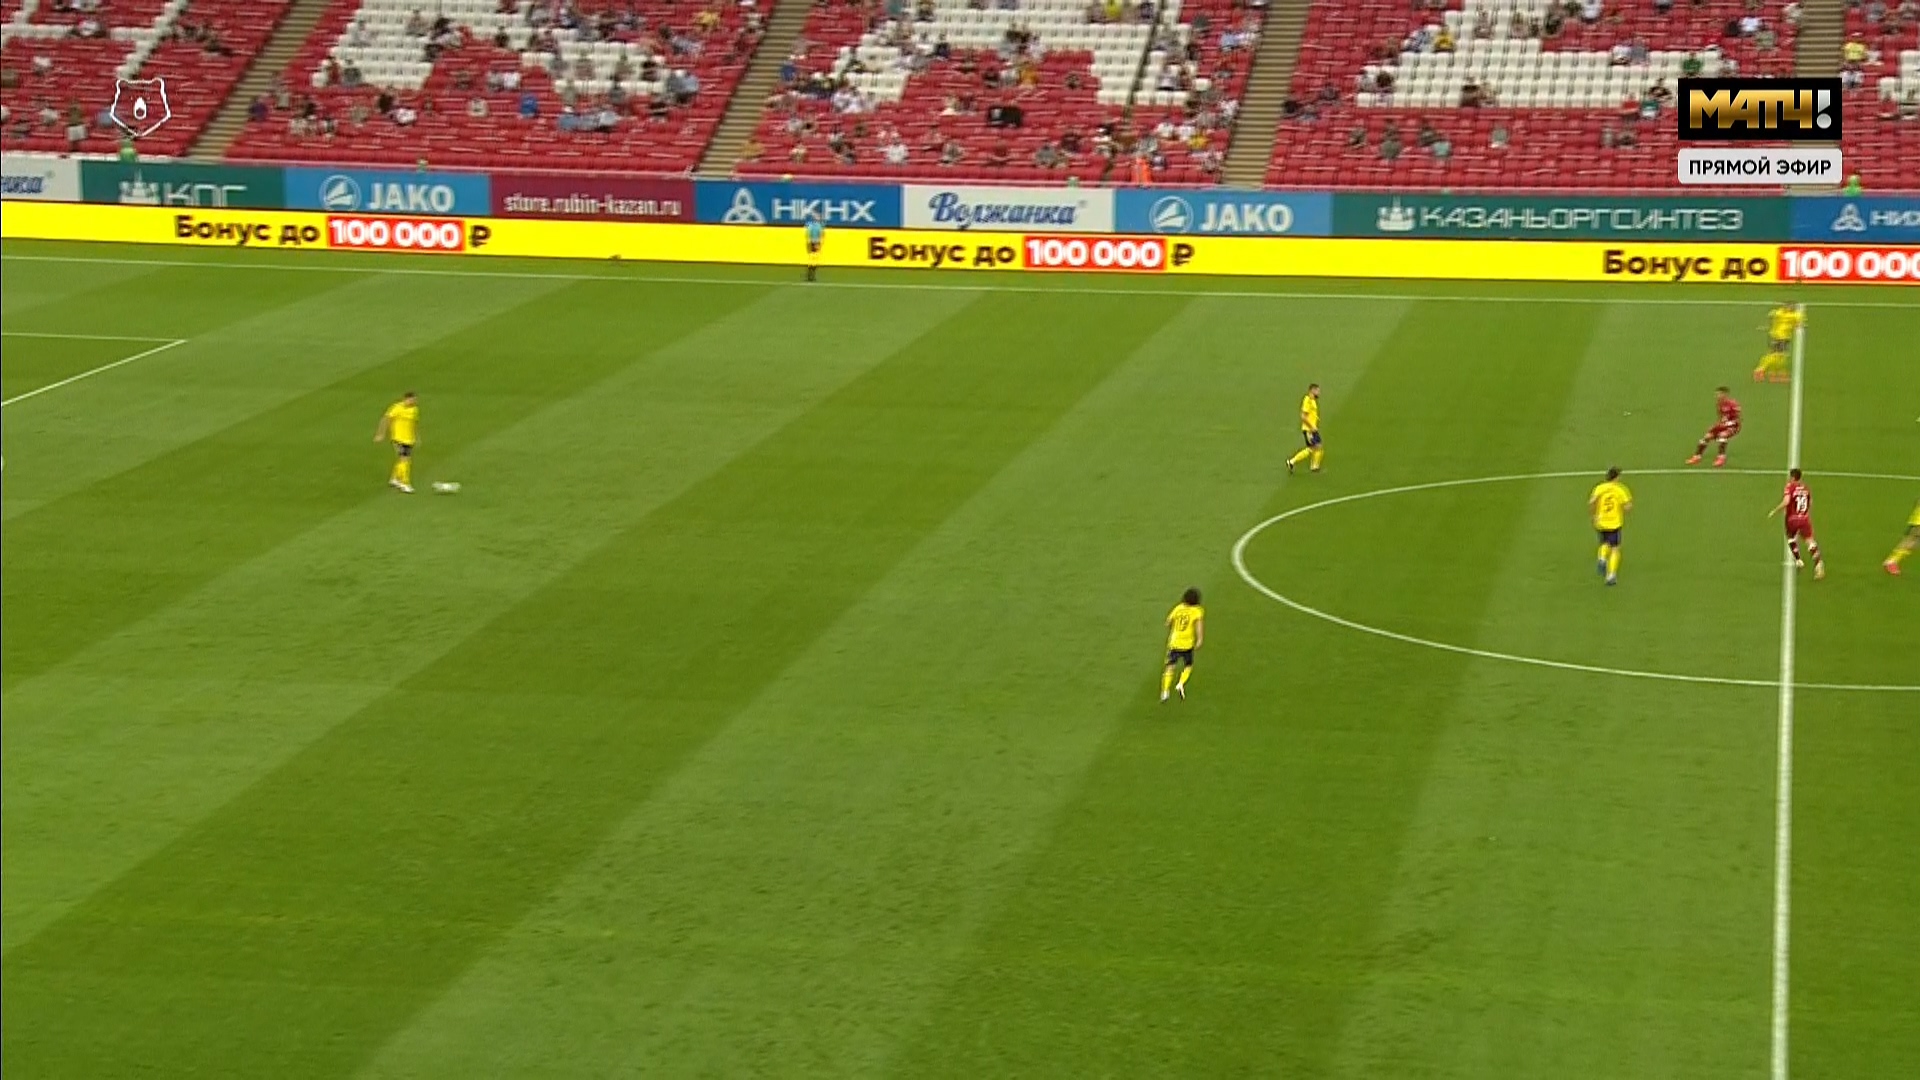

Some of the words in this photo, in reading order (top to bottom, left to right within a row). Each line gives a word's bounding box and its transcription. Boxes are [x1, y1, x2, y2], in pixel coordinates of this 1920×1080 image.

[367, 182, 455, 212] JAKO
[504, 192, 682, 216] store.rubin-kazan.ru
[772, 198, 876, 222] НКНХ
[929, 191, 1077, 231] Волжанка
[174, 215, 271, 246] Бонус
[279, 223, 321, 245] до
[330, 219, 391, 246] 100
[394, 221, 460, 248] 000
[1199, 202, 1294, 232] JAKO
[1419, 206, 1743, 231] КАЗАНЬОРГСИНТЕЗ
[868, 236, 966, 269] Бонус
[974, 244, 1016, 267] до
[1025, 238, 1088, 266] 100
[1090, 239, 1162, 268] 000
[1603, 249, 1712, 282] Бонус
[1720, 255, 1769, 280] до
[1782, 250, 1850, 279] 100
